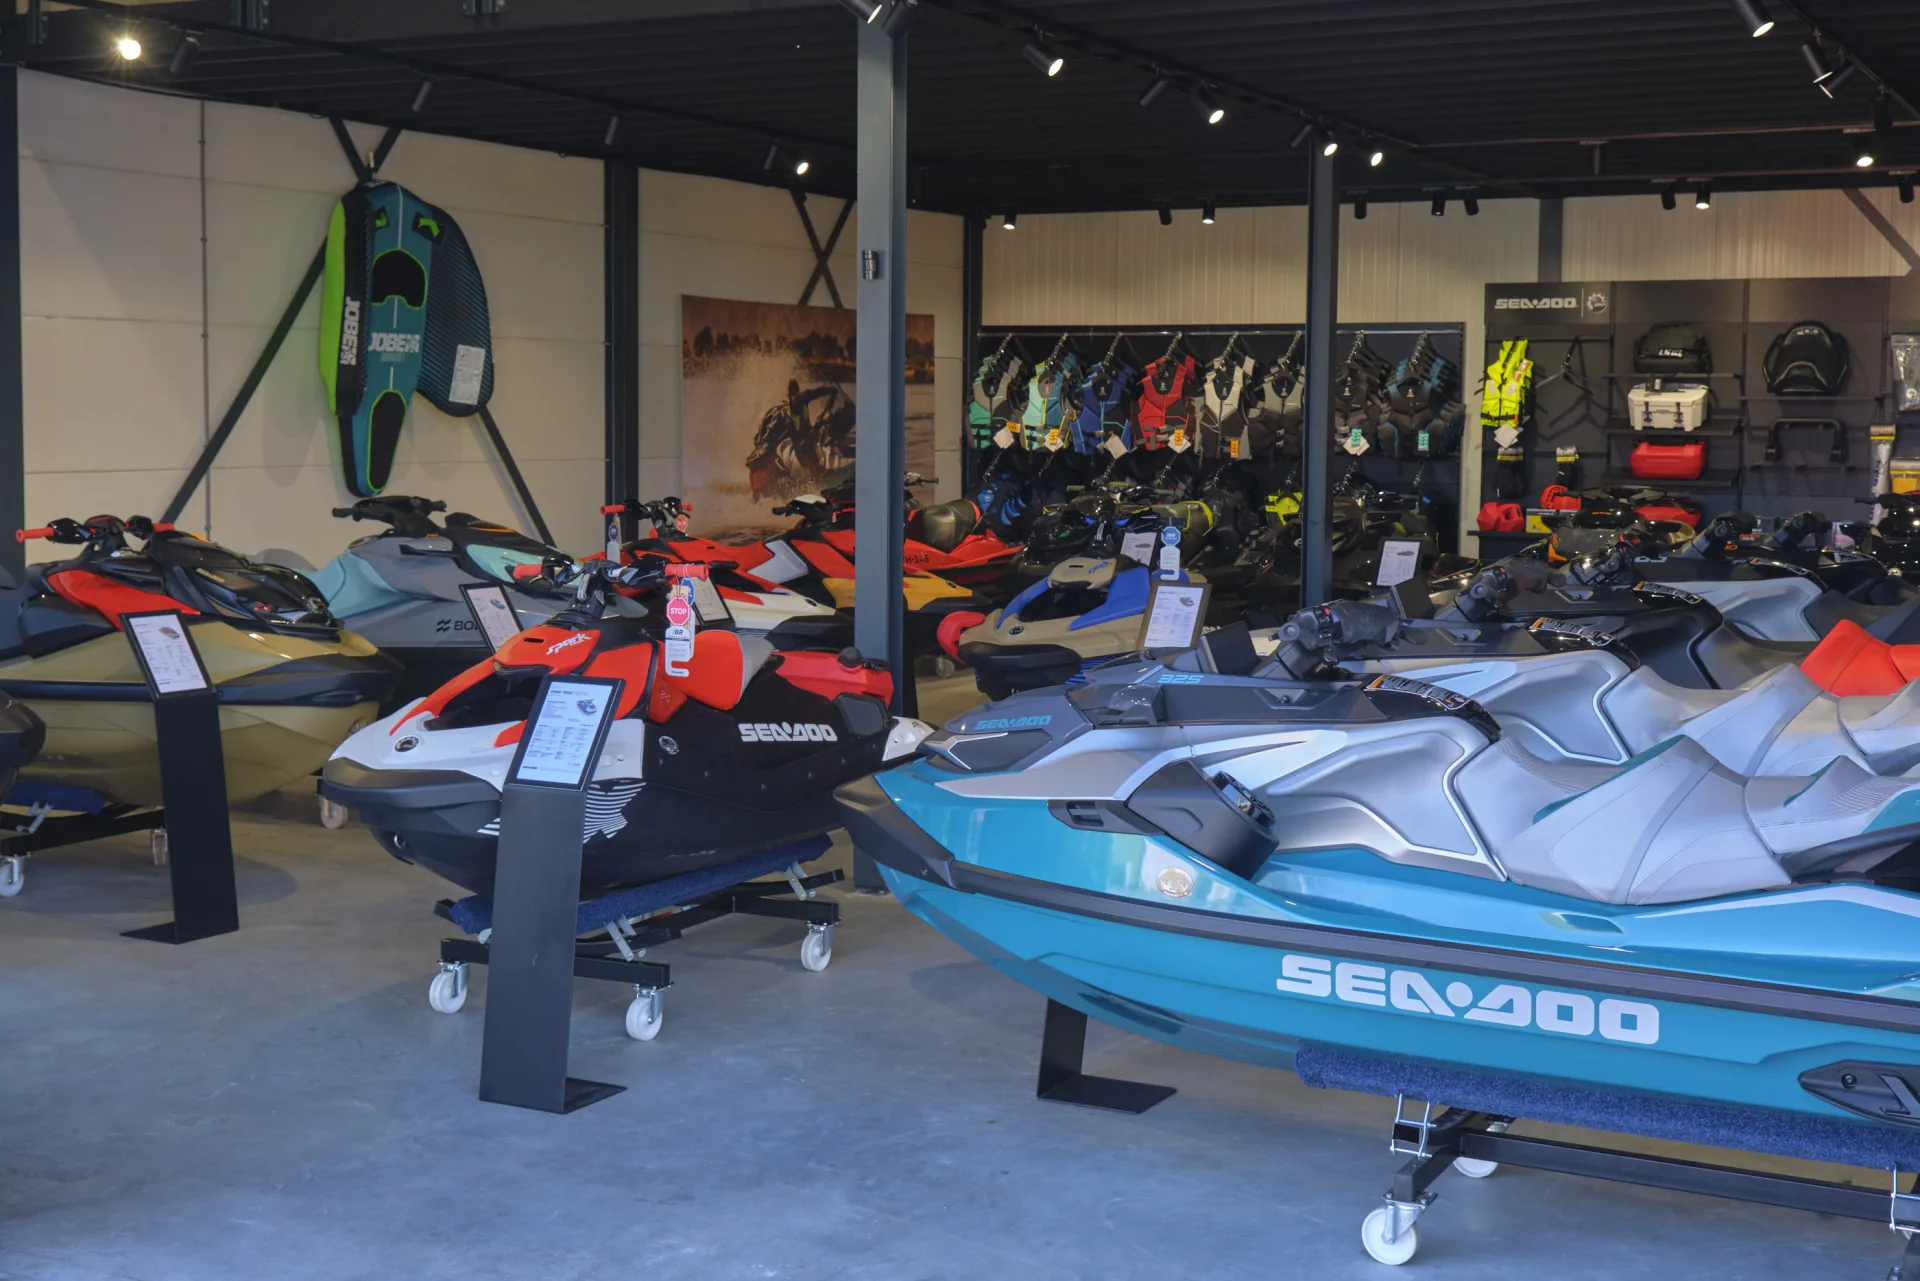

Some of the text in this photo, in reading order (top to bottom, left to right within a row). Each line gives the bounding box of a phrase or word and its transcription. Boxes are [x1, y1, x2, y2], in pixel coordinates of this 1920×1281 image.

[368, 332, 407, 352] JOBE
[670, 607, 687, 615] STOP
[1157, 674, 1204, 685] 325
